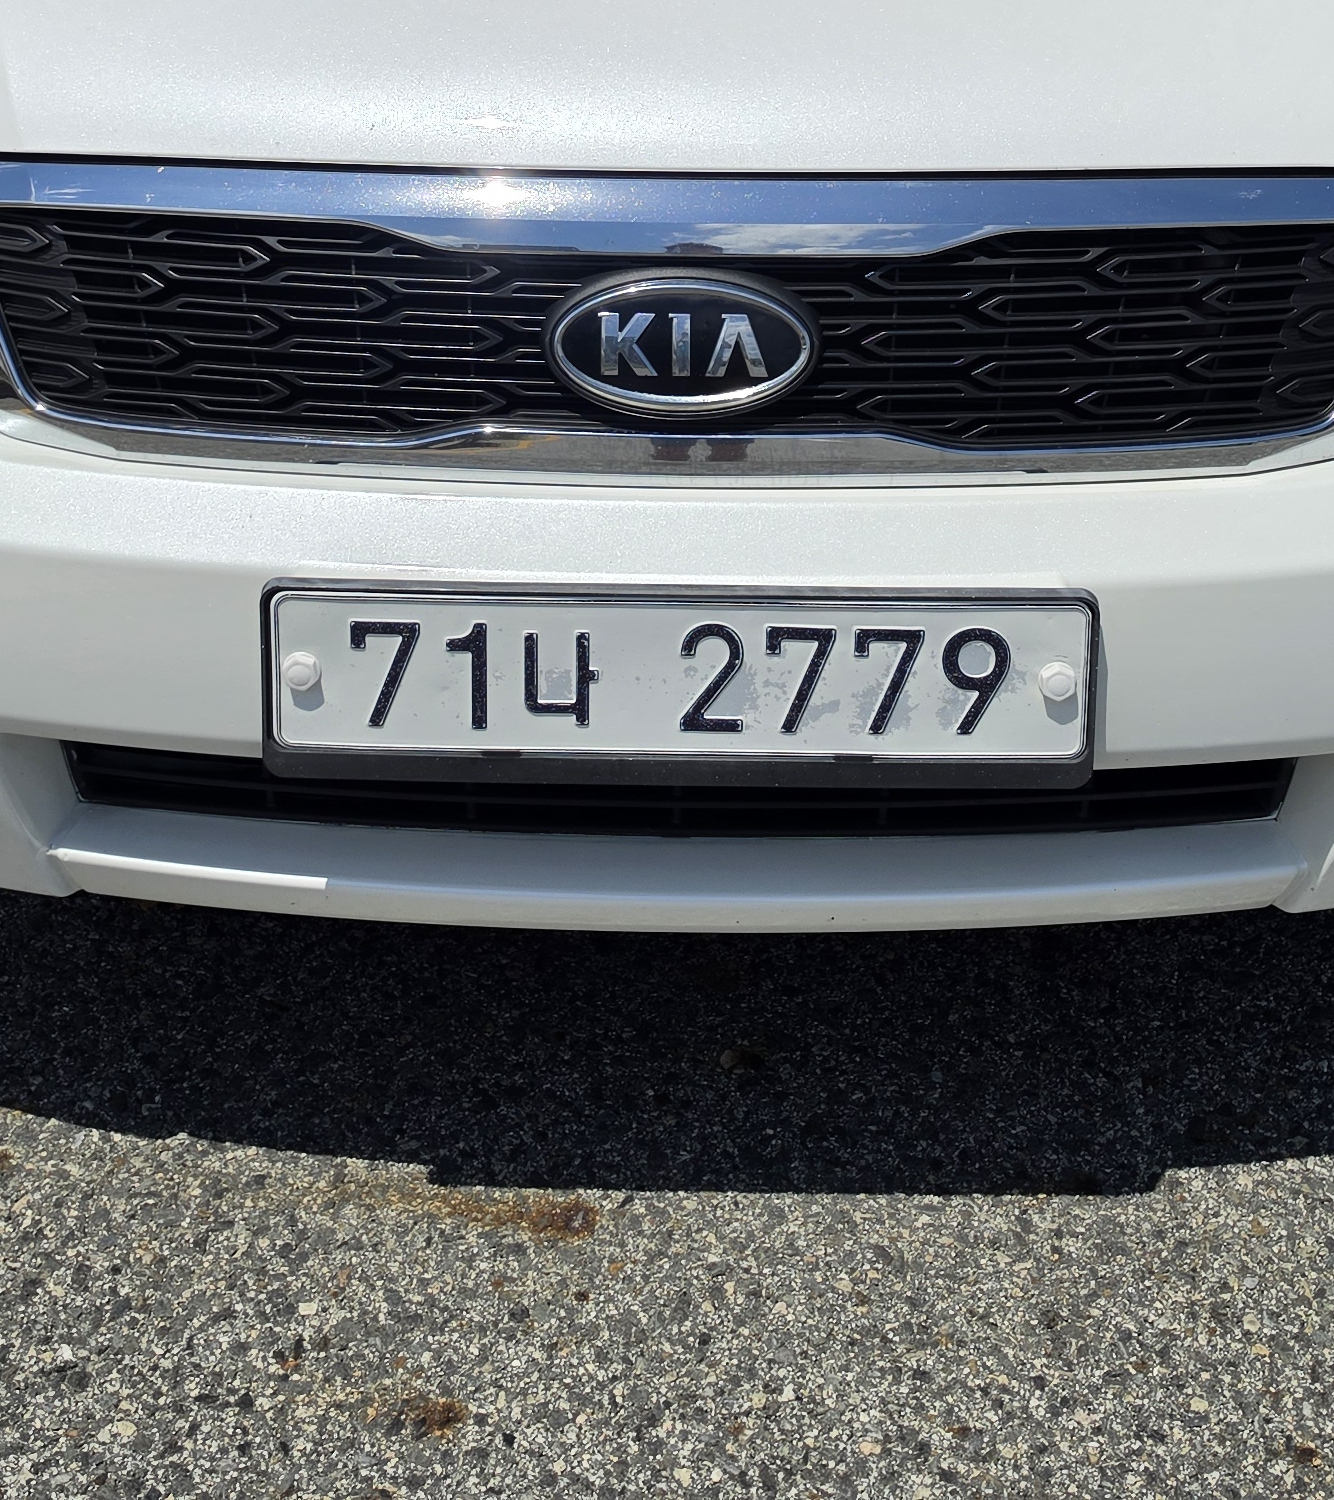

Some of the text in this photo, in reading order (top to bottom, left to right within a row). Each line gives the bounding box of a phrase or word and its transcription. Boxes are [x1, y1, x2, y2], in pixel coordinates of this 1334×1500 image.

[597, 311, 769, 378] KIA
[348, 619, 1013, 737] 71나 2779
